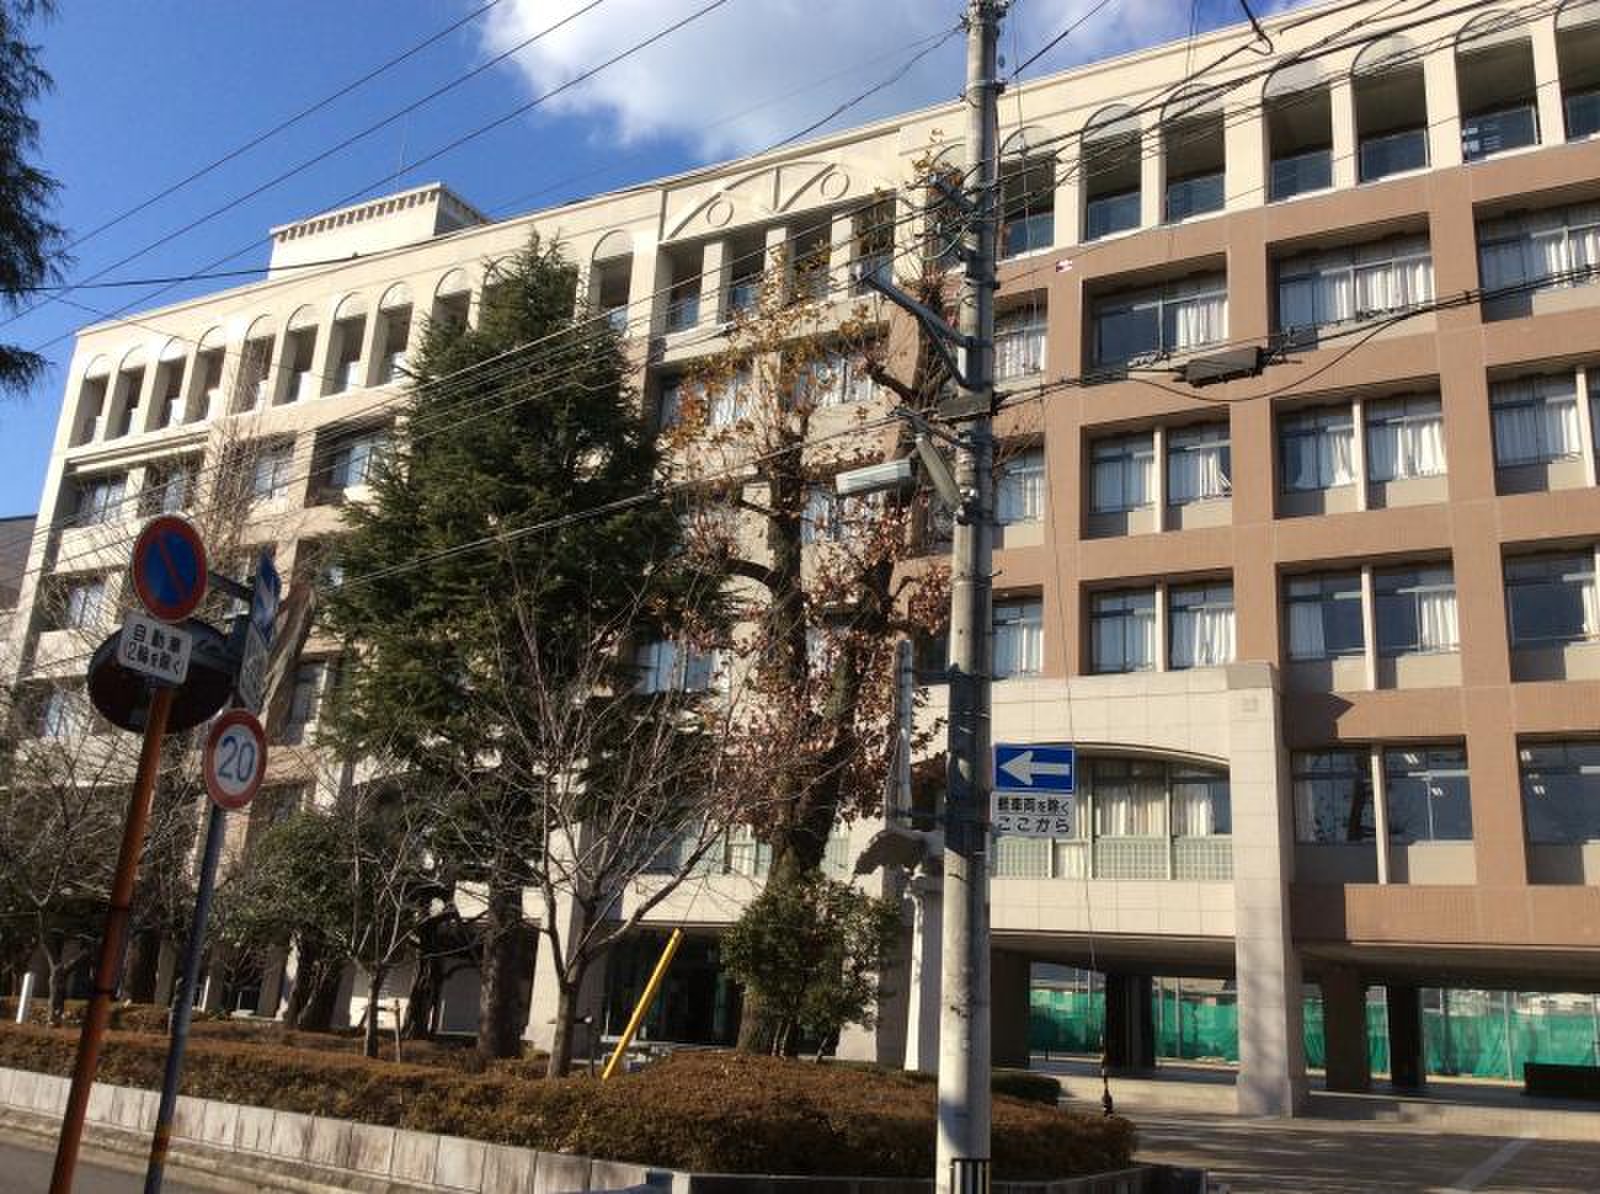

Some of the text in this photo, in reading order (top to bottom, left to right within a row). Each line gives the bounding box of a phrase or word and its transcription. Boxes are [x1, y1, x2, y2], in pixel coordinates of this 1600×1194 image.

[218, 735, 256, 783] 20
[997, 797, 1069, 816] 軽車両を除く
[998, 816, 1070, 833] ここから
